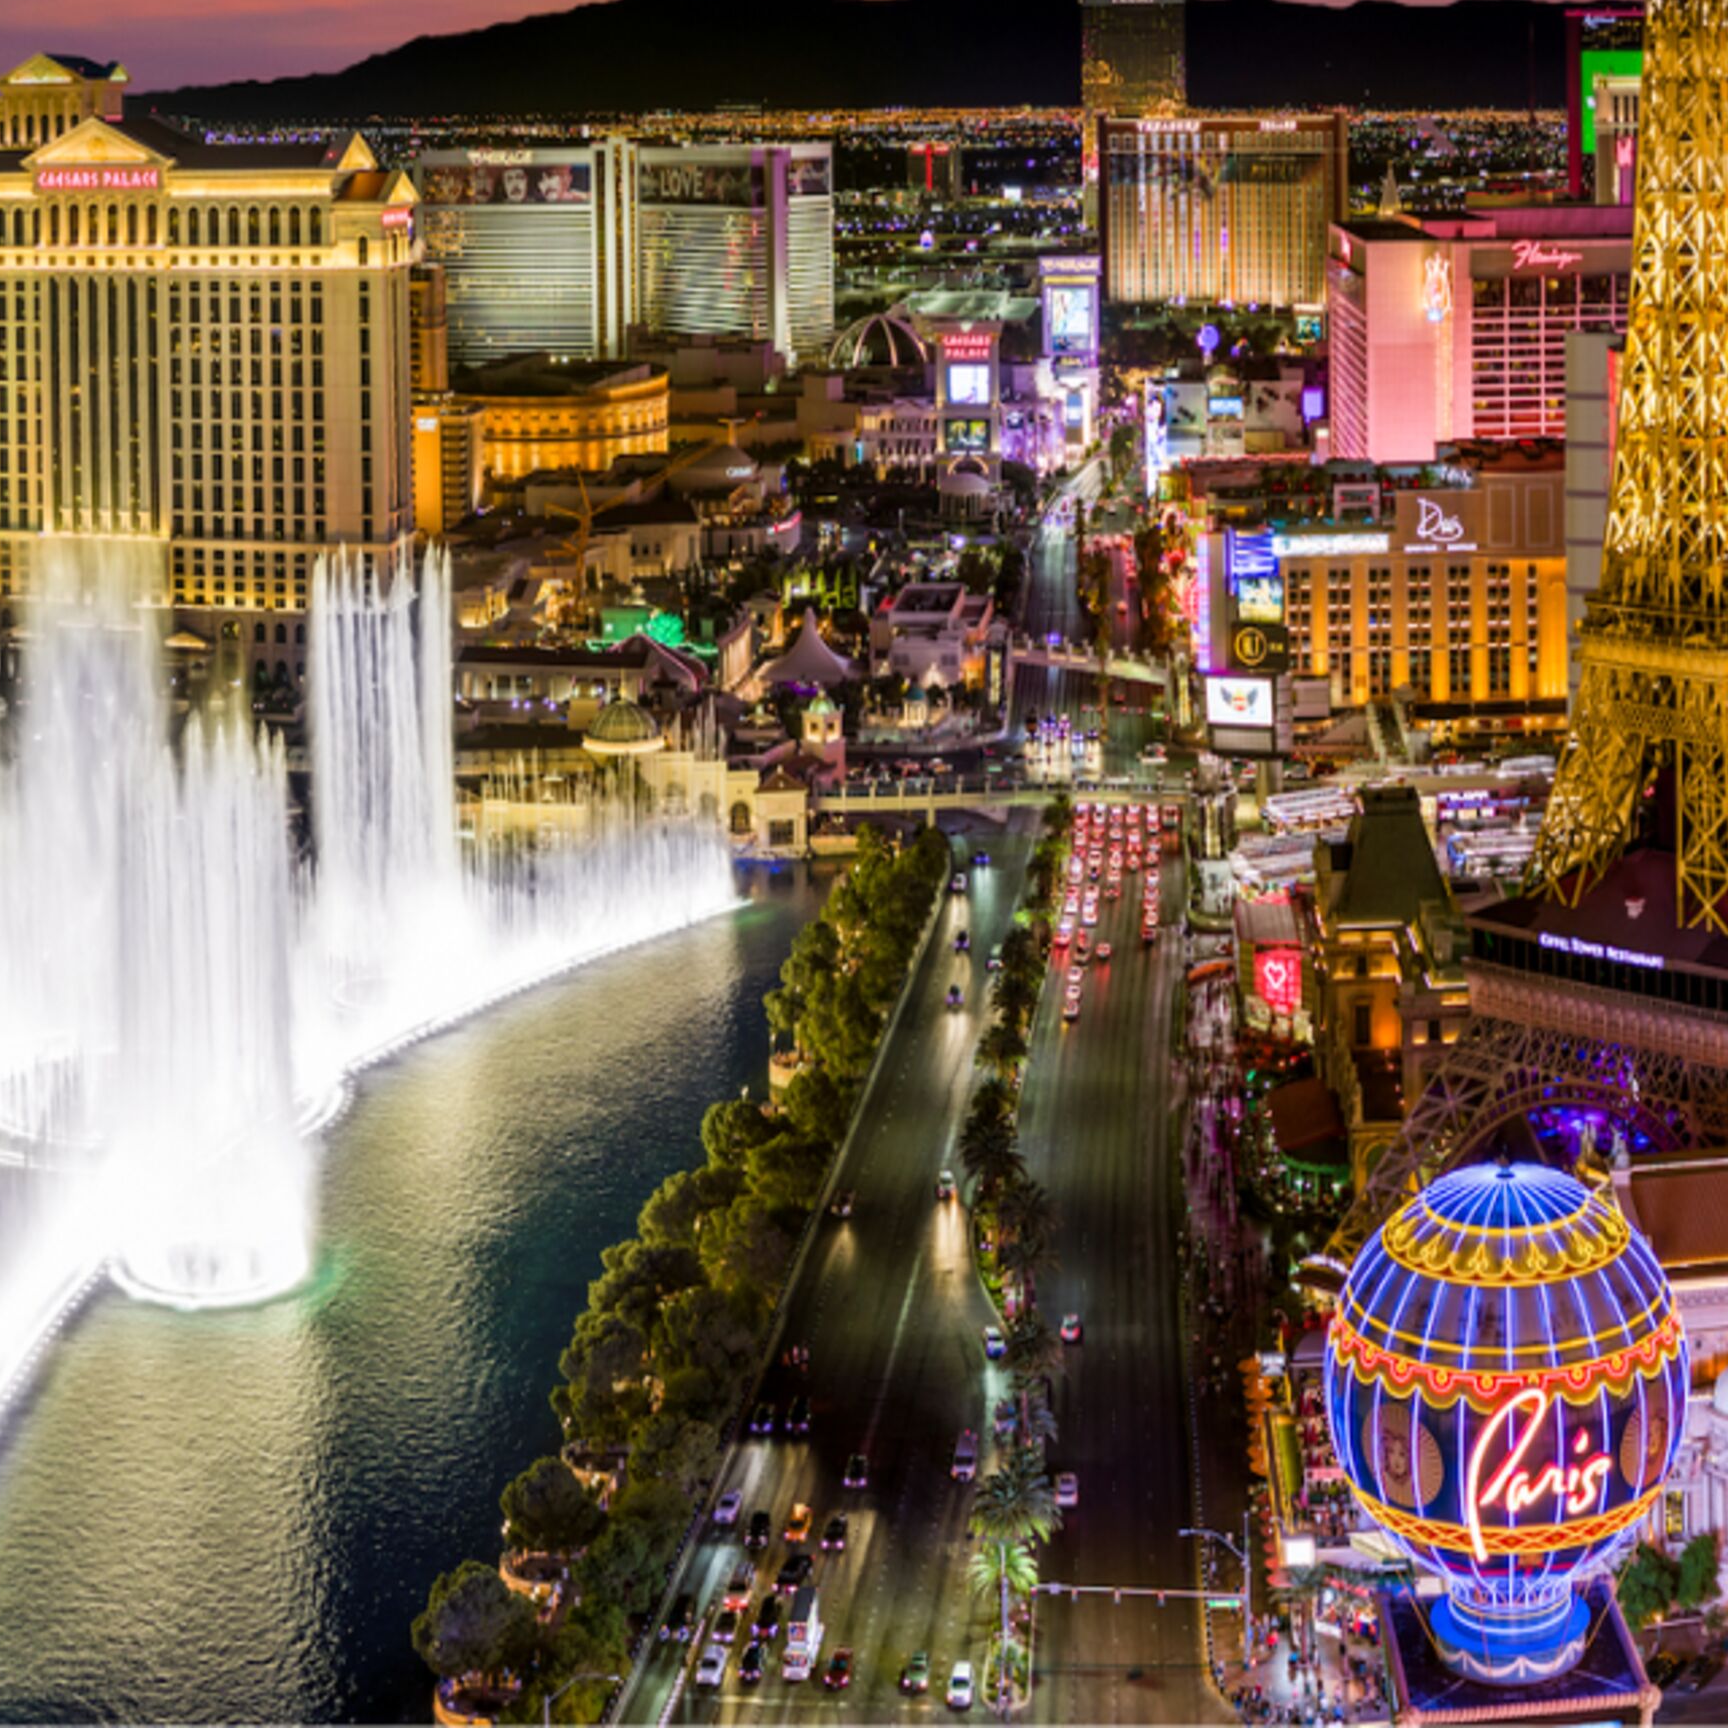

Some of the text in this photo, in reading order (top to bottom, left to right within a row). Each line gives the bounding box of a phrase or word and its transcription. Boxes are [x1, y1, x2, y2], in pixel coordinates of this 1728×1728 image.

[38, 169, 157, 187] CAESARS PALACE
[660, 168, 704, 198] LOVE
[1468, 1387, 1612, 1563] Paris
